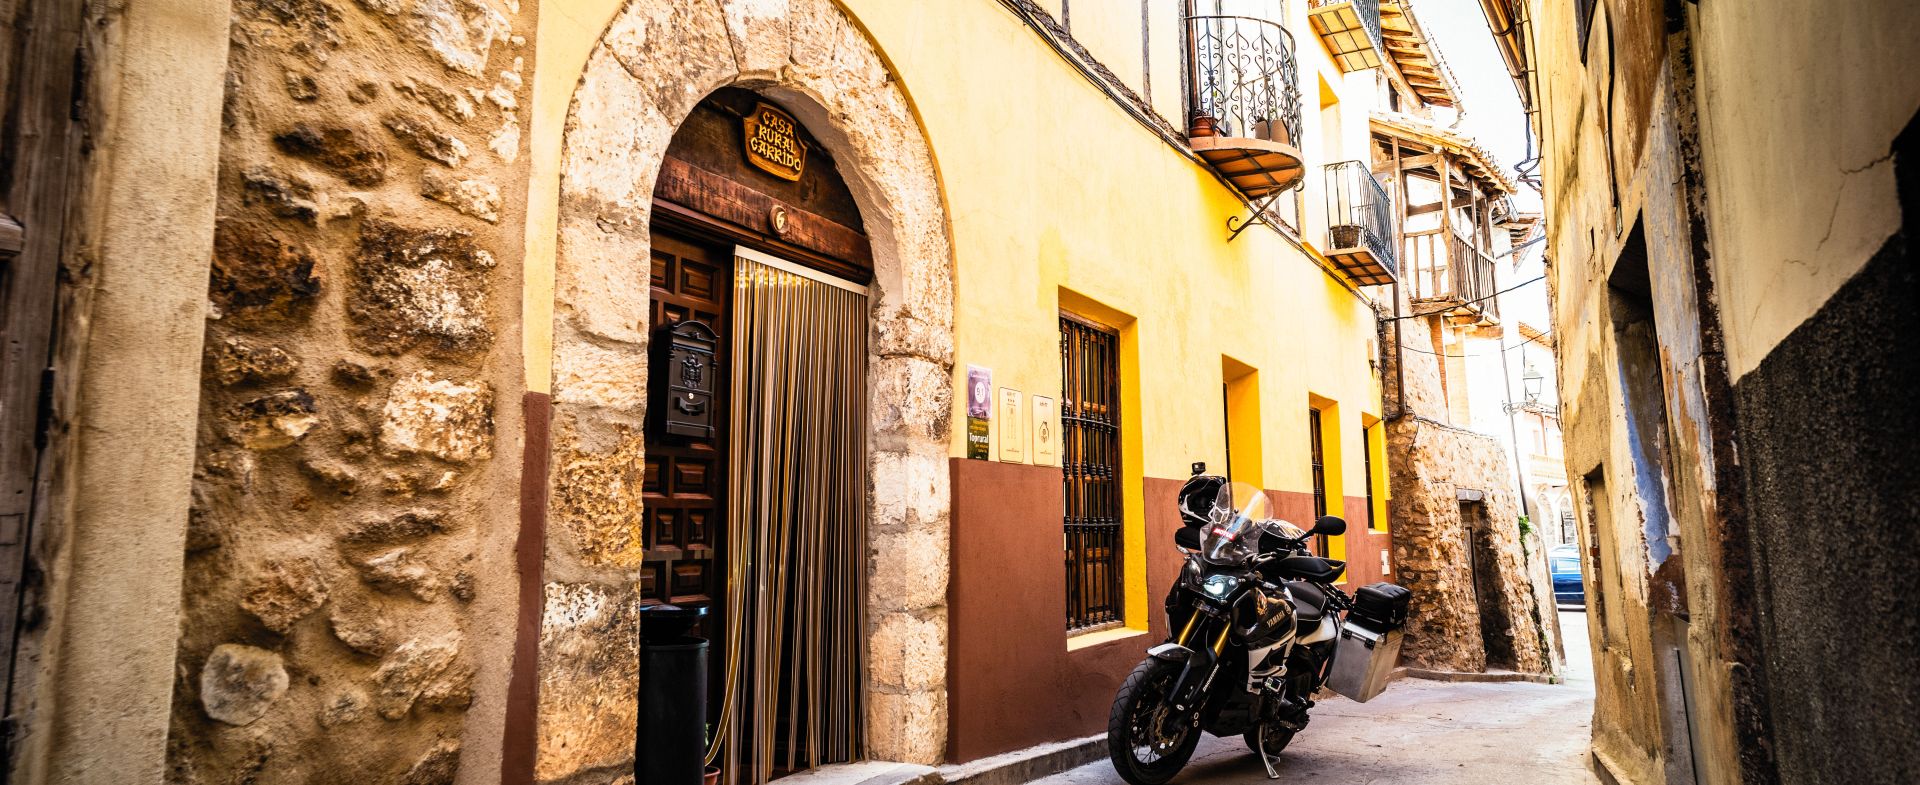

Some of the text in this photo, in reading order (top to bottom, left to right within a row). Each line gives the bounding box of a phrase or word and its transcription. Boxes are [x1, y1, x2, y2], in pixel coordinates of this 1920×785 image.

[763, 111, 793, 137] CASA
[758, 123, 797, 155] RURAL
[751, 137, 801, 171] GARRIDO
[776, 211, 785, 230] 6
[1266, 609, 1286, 628] YAMAHA
